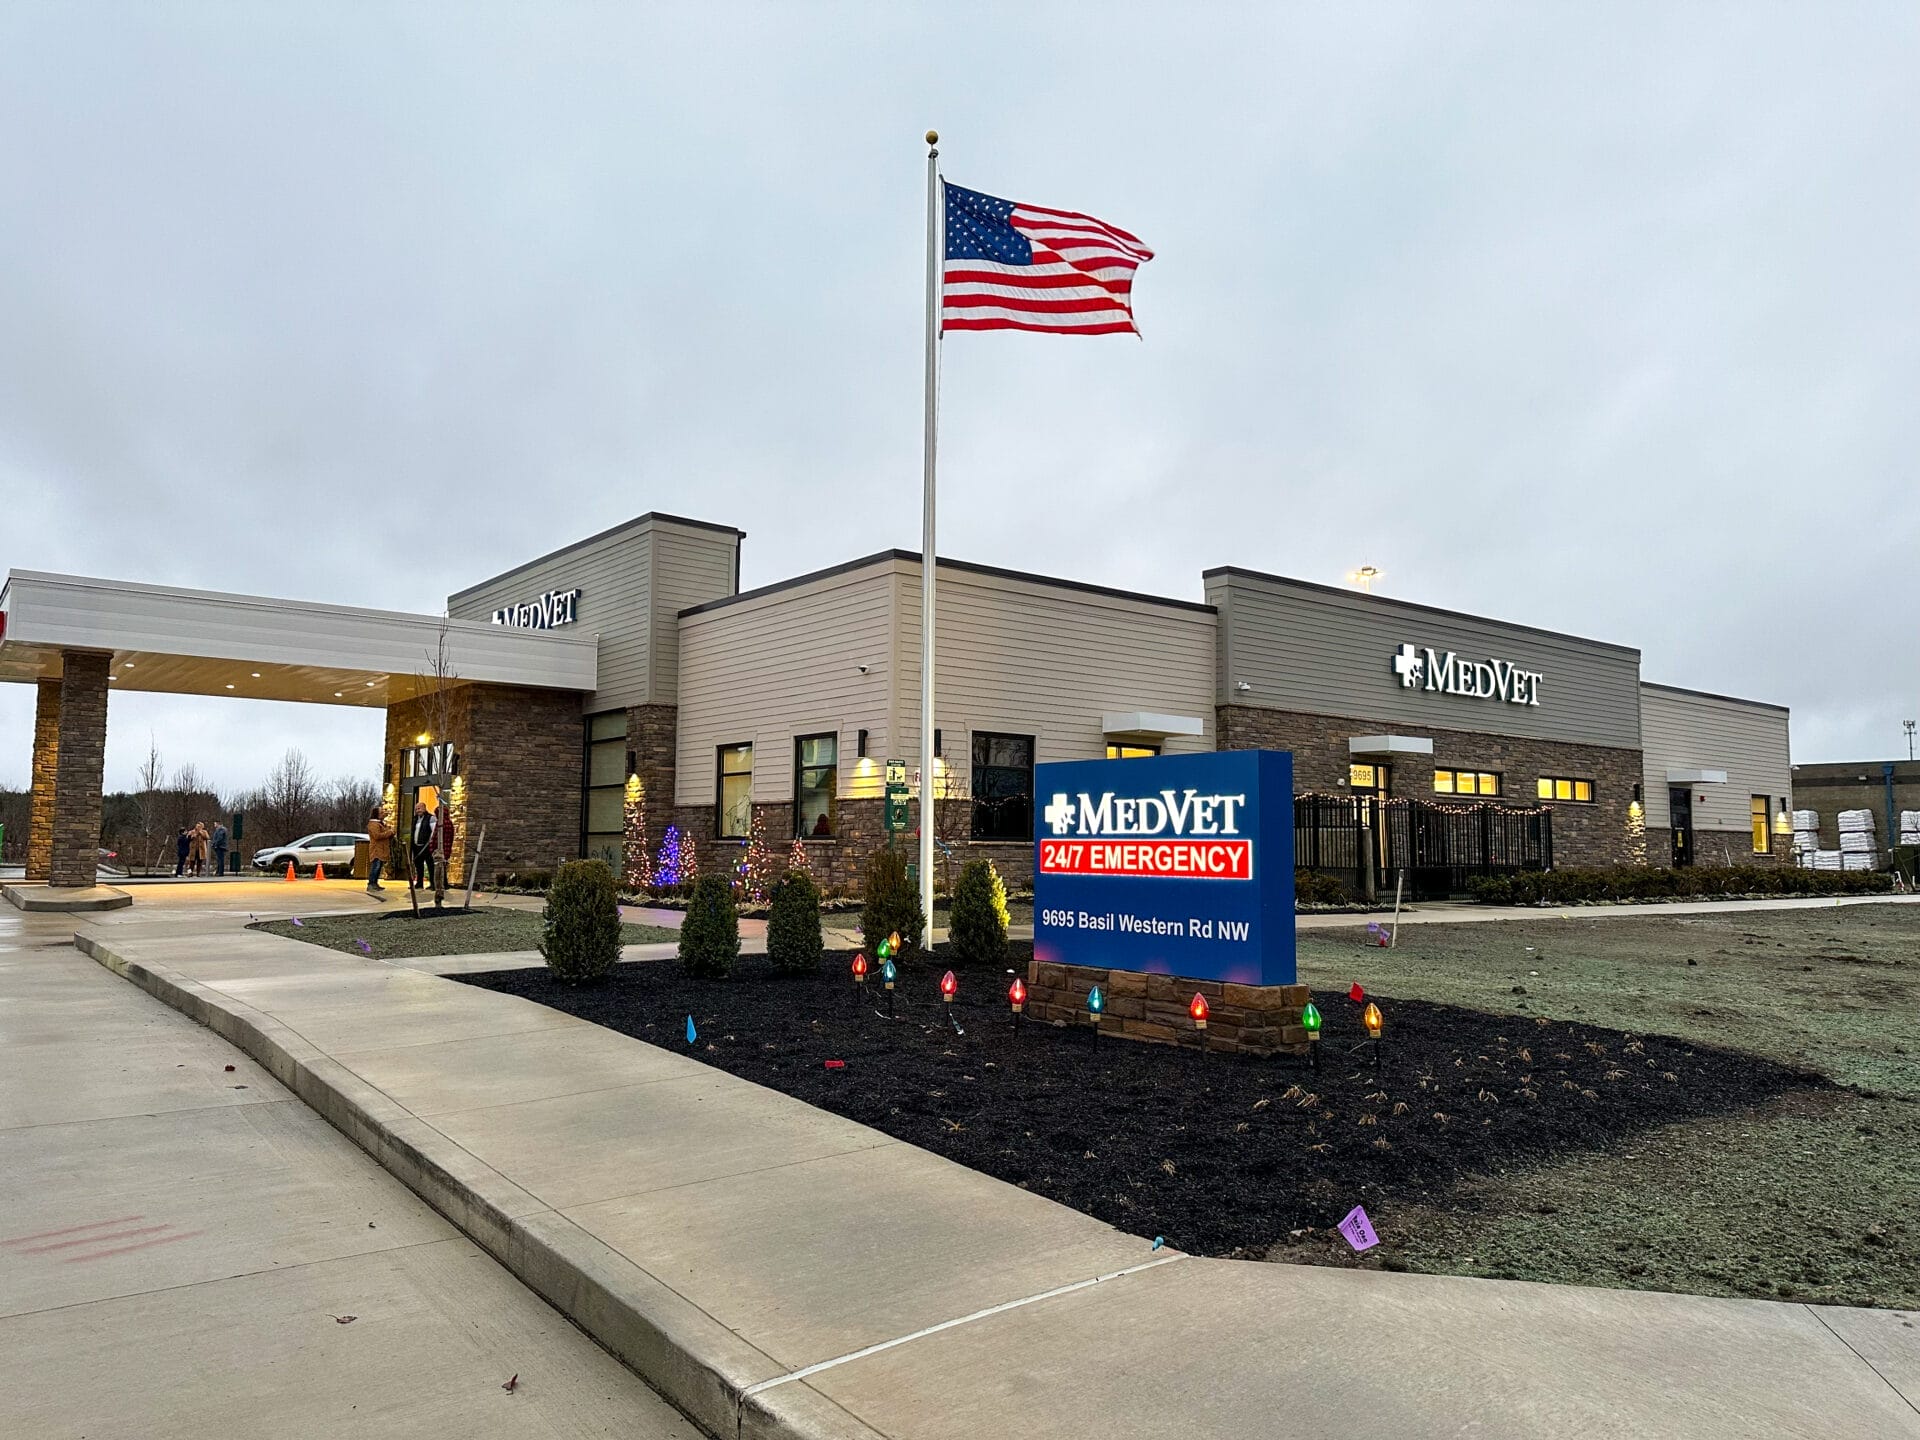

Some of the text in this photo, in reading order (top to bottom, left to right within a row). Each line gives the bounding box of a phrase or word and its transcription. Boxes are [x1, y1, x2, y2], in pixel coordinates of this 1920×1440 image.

[1353, 770, 1372, 781] 9695
[1044, 845, 1244, 872] 24/7 EMERGENCY
[1042, 909, 1249, 941] 9695 Basil Western Rd NW
